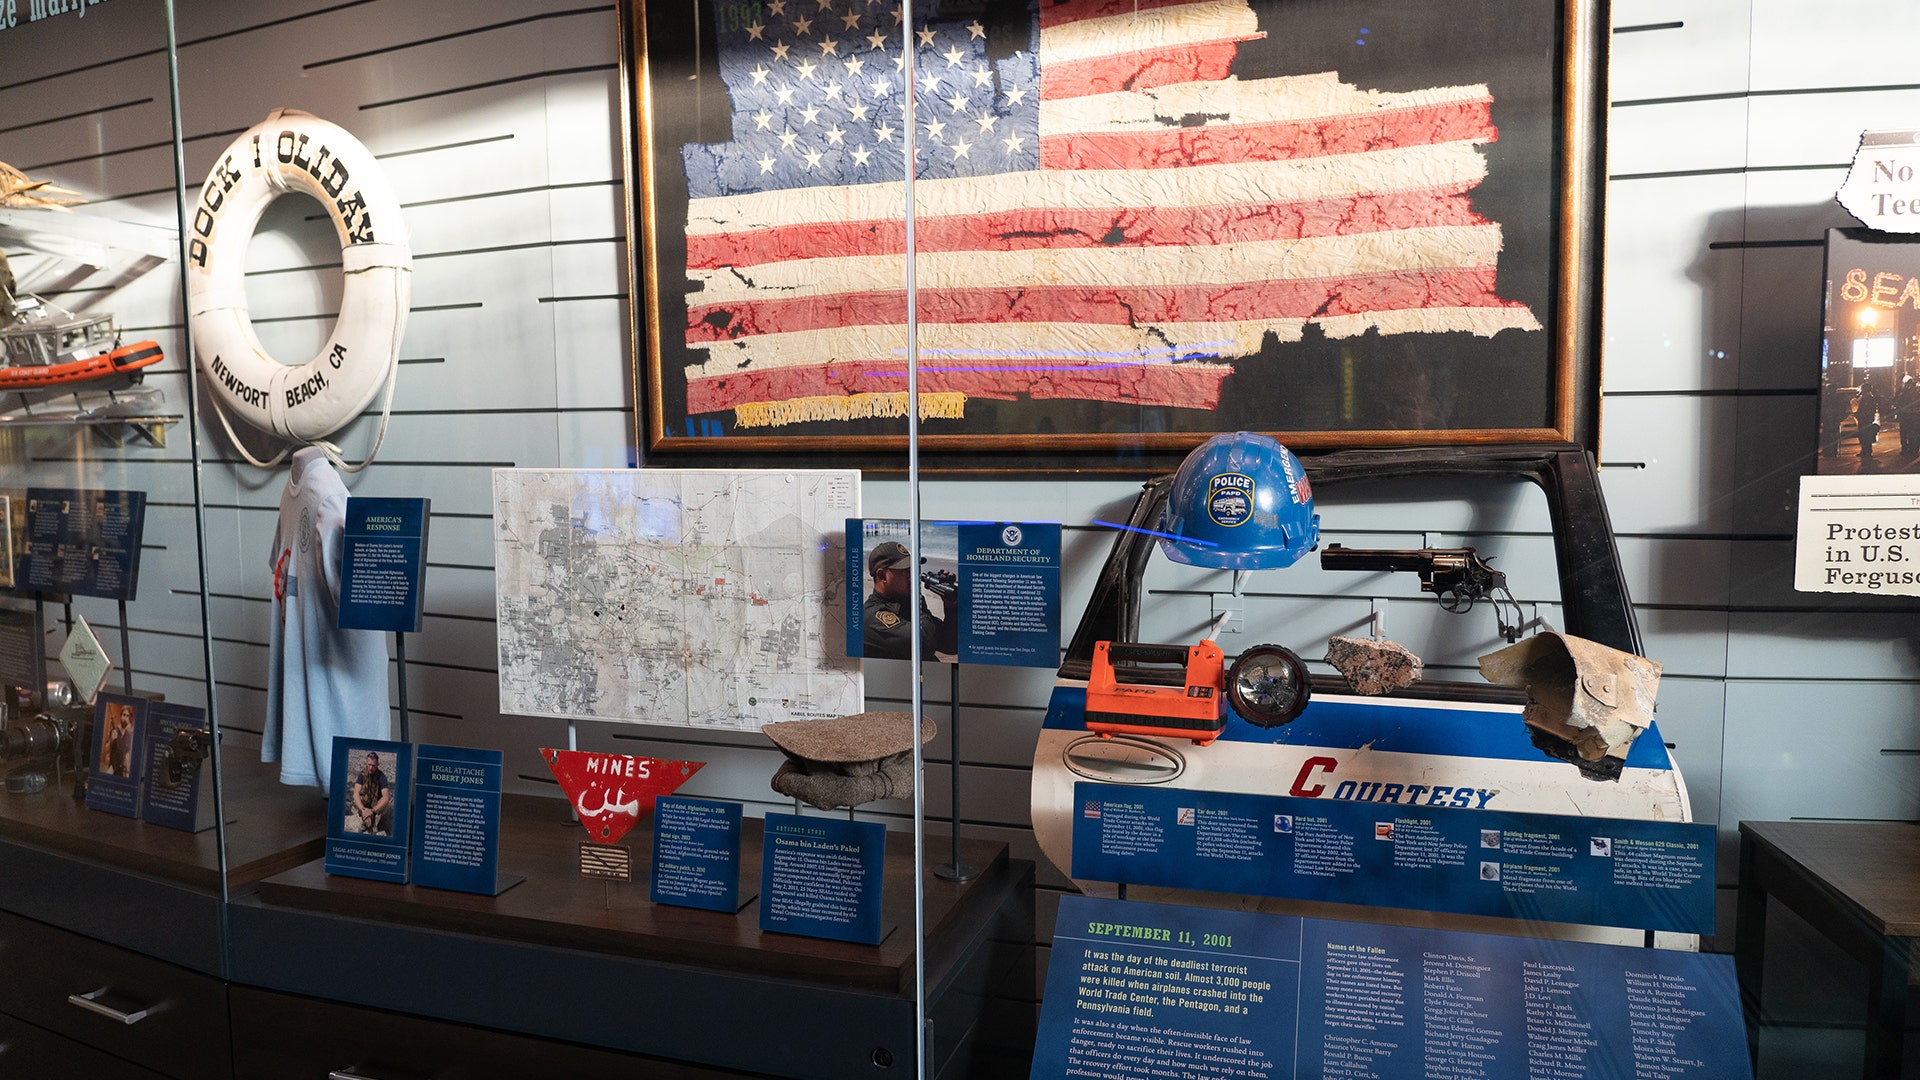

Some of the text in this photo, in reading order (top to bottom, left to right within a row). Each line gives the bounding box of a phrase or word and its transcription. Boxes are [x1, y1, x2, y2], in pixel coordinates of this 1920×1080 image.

[1873, 159, 1914, 183] No
[189, 155, 241, 268] DOCK
[212, 343, 347, 409] NEWPORT BEACH, CA
[1214, 477, 1250, 488] POLICE
[1825, 545, 1909, 562] in U.S.
[432, 765, 485, 776] LEGAL ATTACHÉ
[586, 757, 650, 779] MINES
[432, 774, 484, 784] ROBERT JONES
[1289, 756, 1500, 809] COURTESY
[775, 838, 860, 853] Osama bin Laden's Pakol
[1088, 923, 1232, 947] SEPTEMBER 11, 2001
[1367, 946, 1386, 954] Fallen
[1084, 949, 1247, 974] It was the day of the deadliest terrorist
[1538, 963, 1575, 972] Laszczynski
[1082, 963, 1271, 991] attack on American soil. Almost 3,000 people
[1543, 971, 1562, 979] Leahy
[1625, 971, 1685, 982] Dominick Pezzulo
[1081, 976, 1263, 1003] were killed when airplanes crashed into the
[1079, 987, 1102, 997] World
[1105, 990, 1127, 1000] Trade
[1130, 993, 1159, 1005] Center,
[1162, 996, 1176, 1006] the
[1178, 998, 1221, 1012] Pentagon,
[1224, 1005, 1240, 1014] and
[1627, 995, 1681, 1005] Claude Richards
[1076, 1000, 1154, 1017] Pennsylvania field.
[1424, 1022, 1503, 1036] Thomas Edward Gorman
[1631, 1028, 1675, 1039] Timothy Roy
[1527, 1033, 1549, 1041] Walter
[1573, 1038, 1598, 1046] McNeil
[1633, 1044, 1676, 1055] Moira Smith
[1323, 1058, 1368, 1069] Liam Callahan
